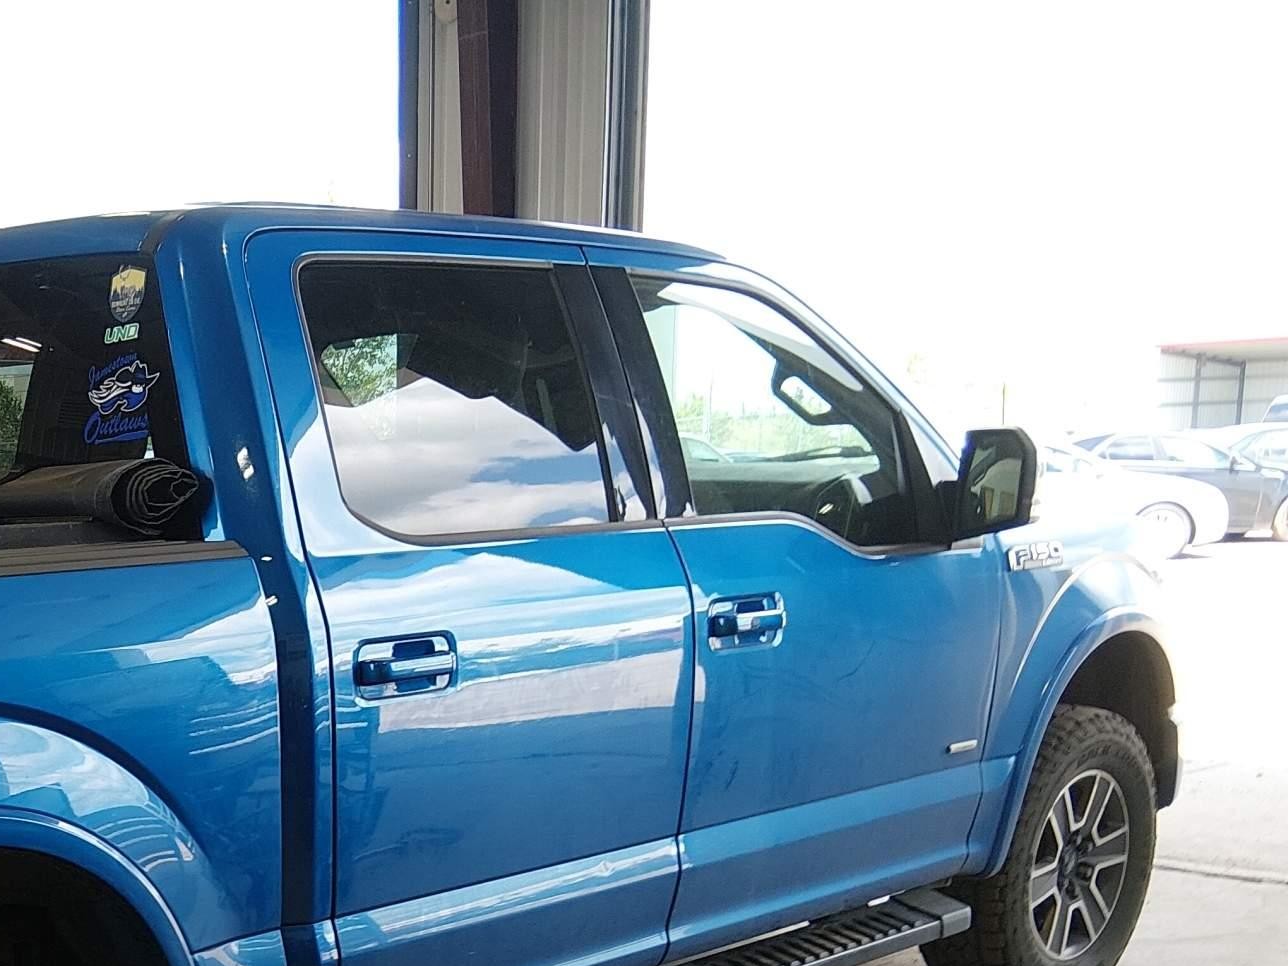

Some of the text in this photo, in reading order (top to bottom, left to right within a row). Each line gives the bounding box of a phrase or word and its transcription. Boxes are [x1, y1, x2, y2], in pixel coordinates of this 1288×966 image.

[103, 323, 140, 345] UND
[88, 352, 138, 389] Jamestown
[83, 410, 149, 445] Outlaws
